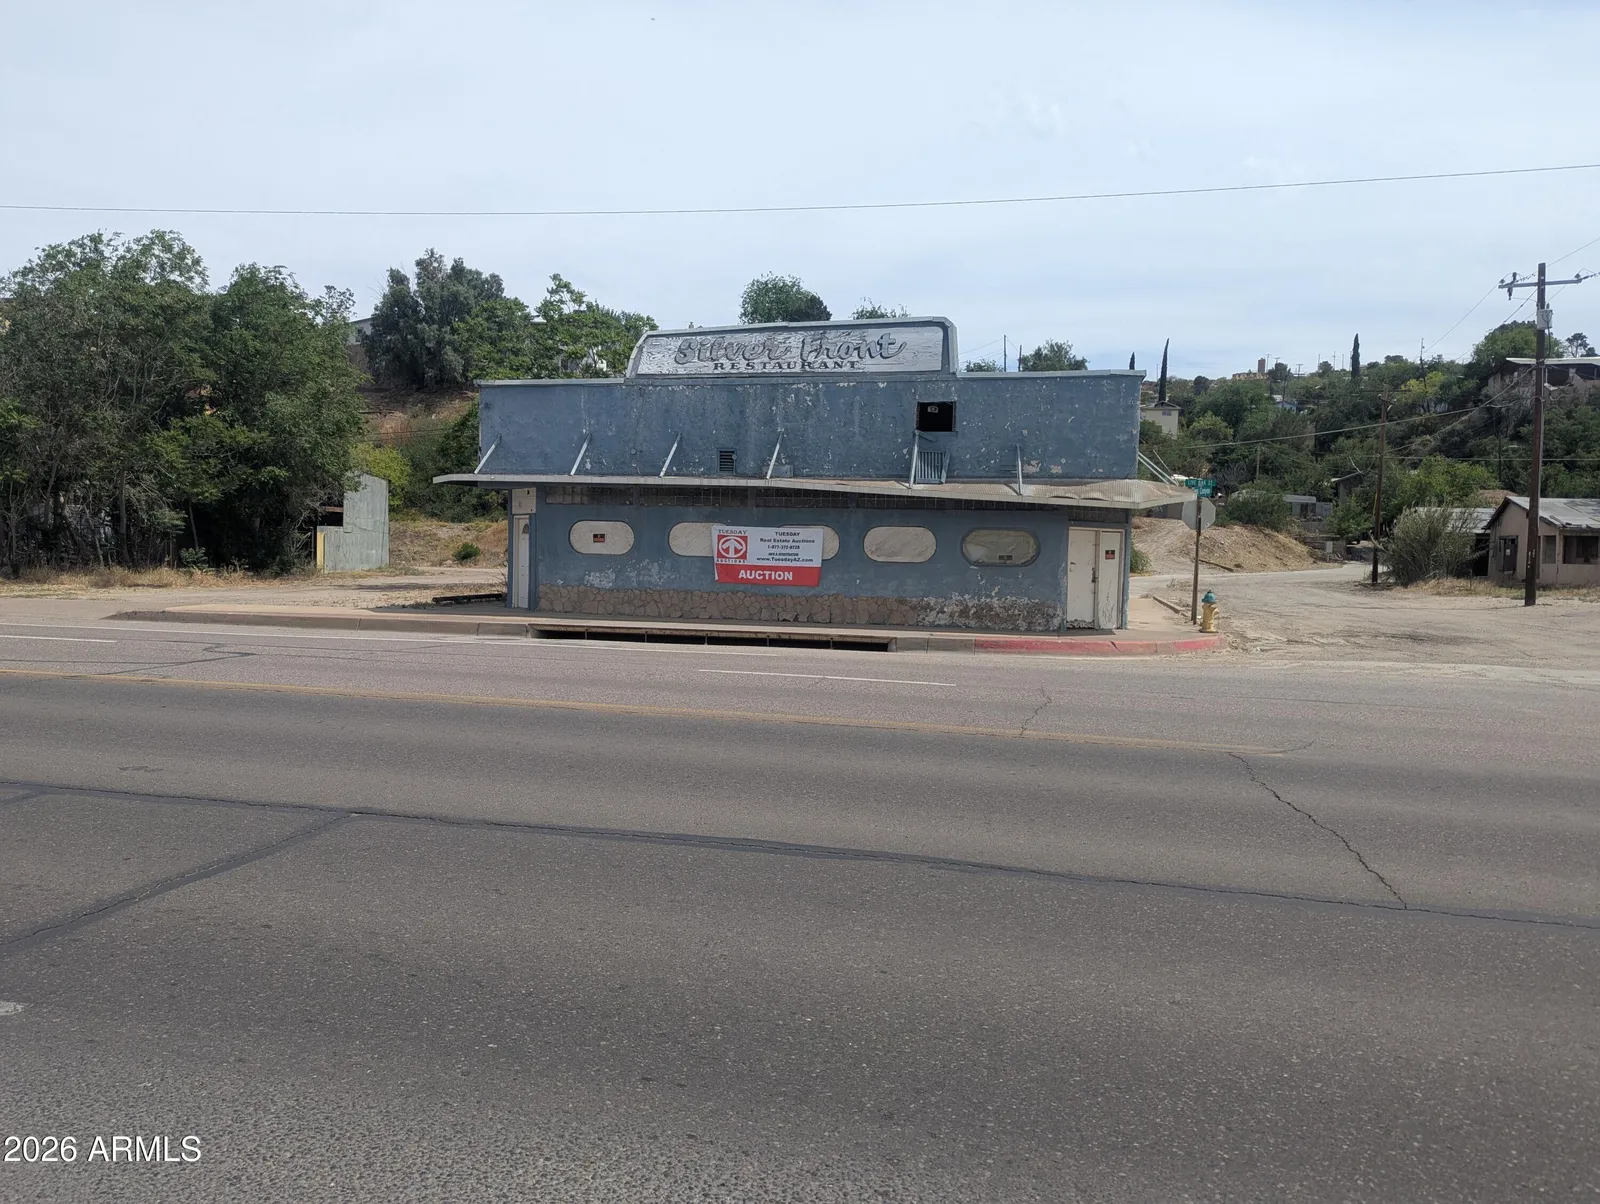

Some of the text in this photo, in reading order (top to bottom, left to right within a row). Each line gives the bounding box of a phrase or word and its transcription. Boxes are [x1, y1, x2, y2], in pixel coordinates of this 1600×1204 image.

[800, 332, 907, 362] Front
[713, 359, 860, 371] RESTAURANT
[738, 569, 793, 581] AUCTION
